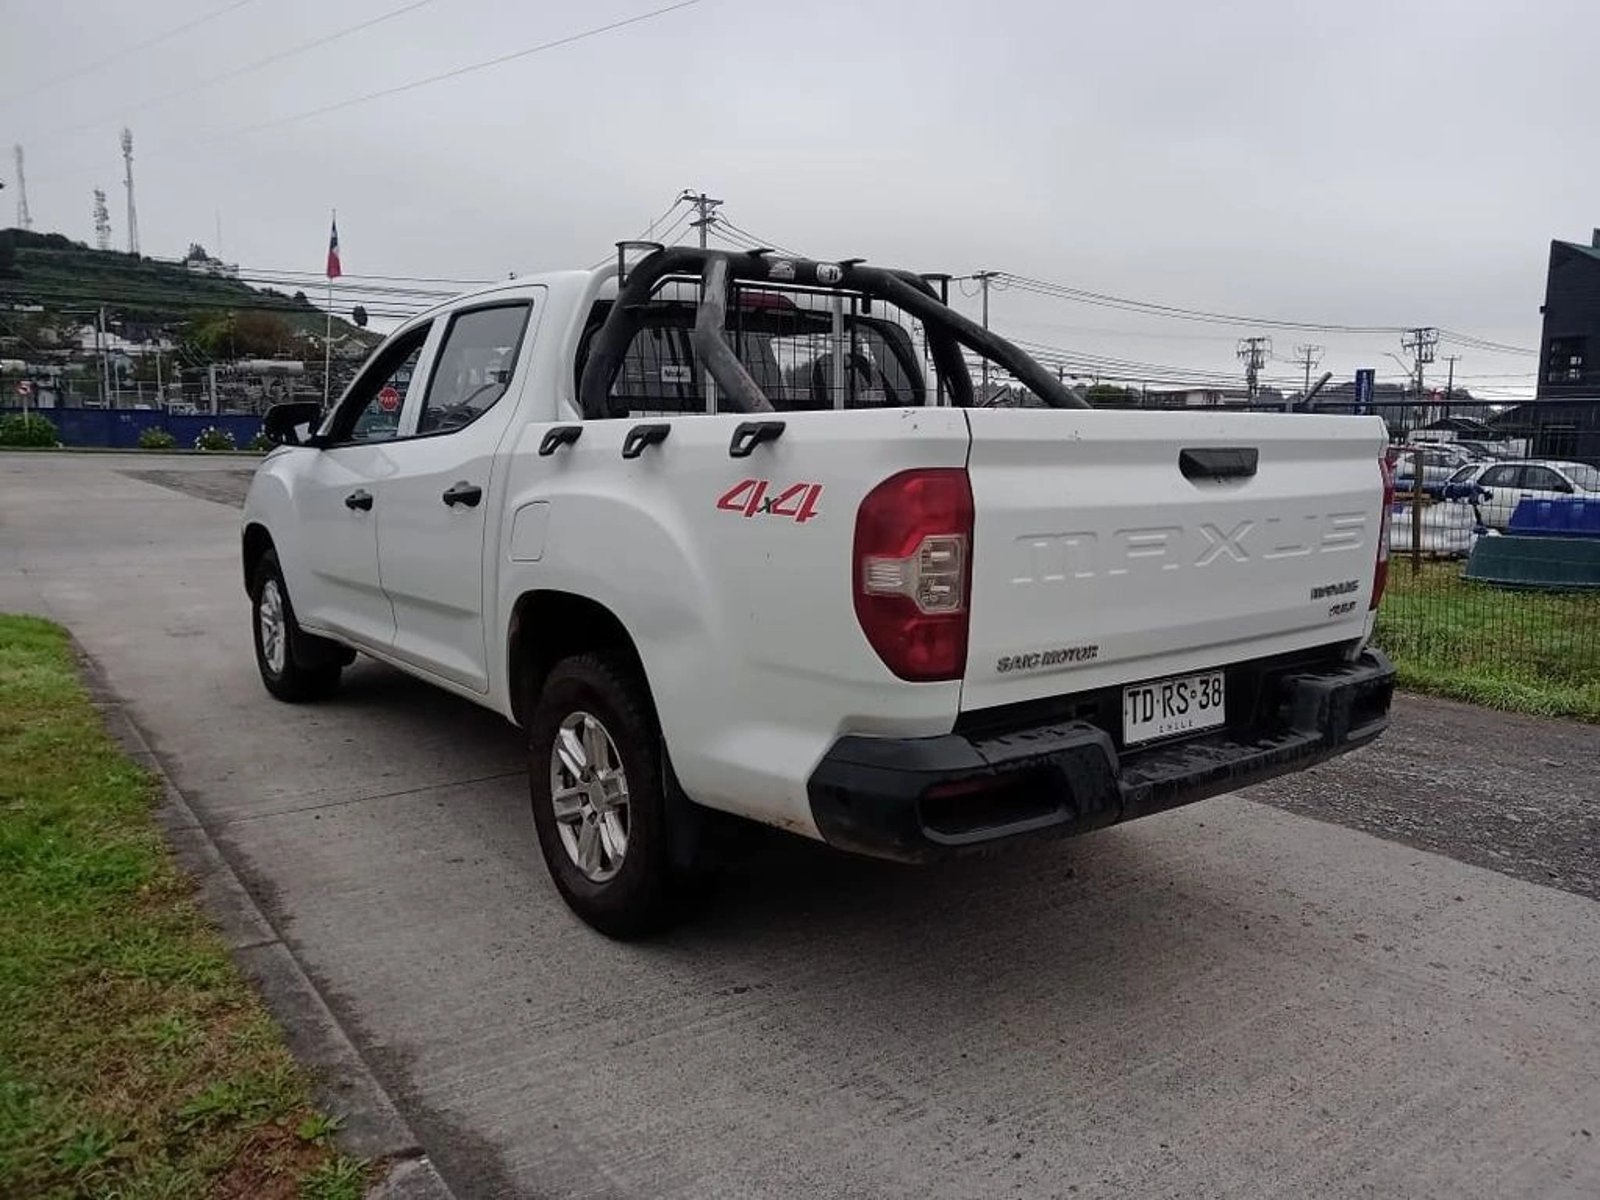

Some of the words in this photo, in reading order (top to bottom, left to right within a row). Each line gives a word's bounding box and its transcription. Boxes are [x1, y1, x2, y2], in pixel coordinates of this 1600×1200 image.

[716, 479, 823, 522] 4x4
[1010, 511, 1367, 584] MAXUS
[1041, 645, 1099, 665] MOTOR
